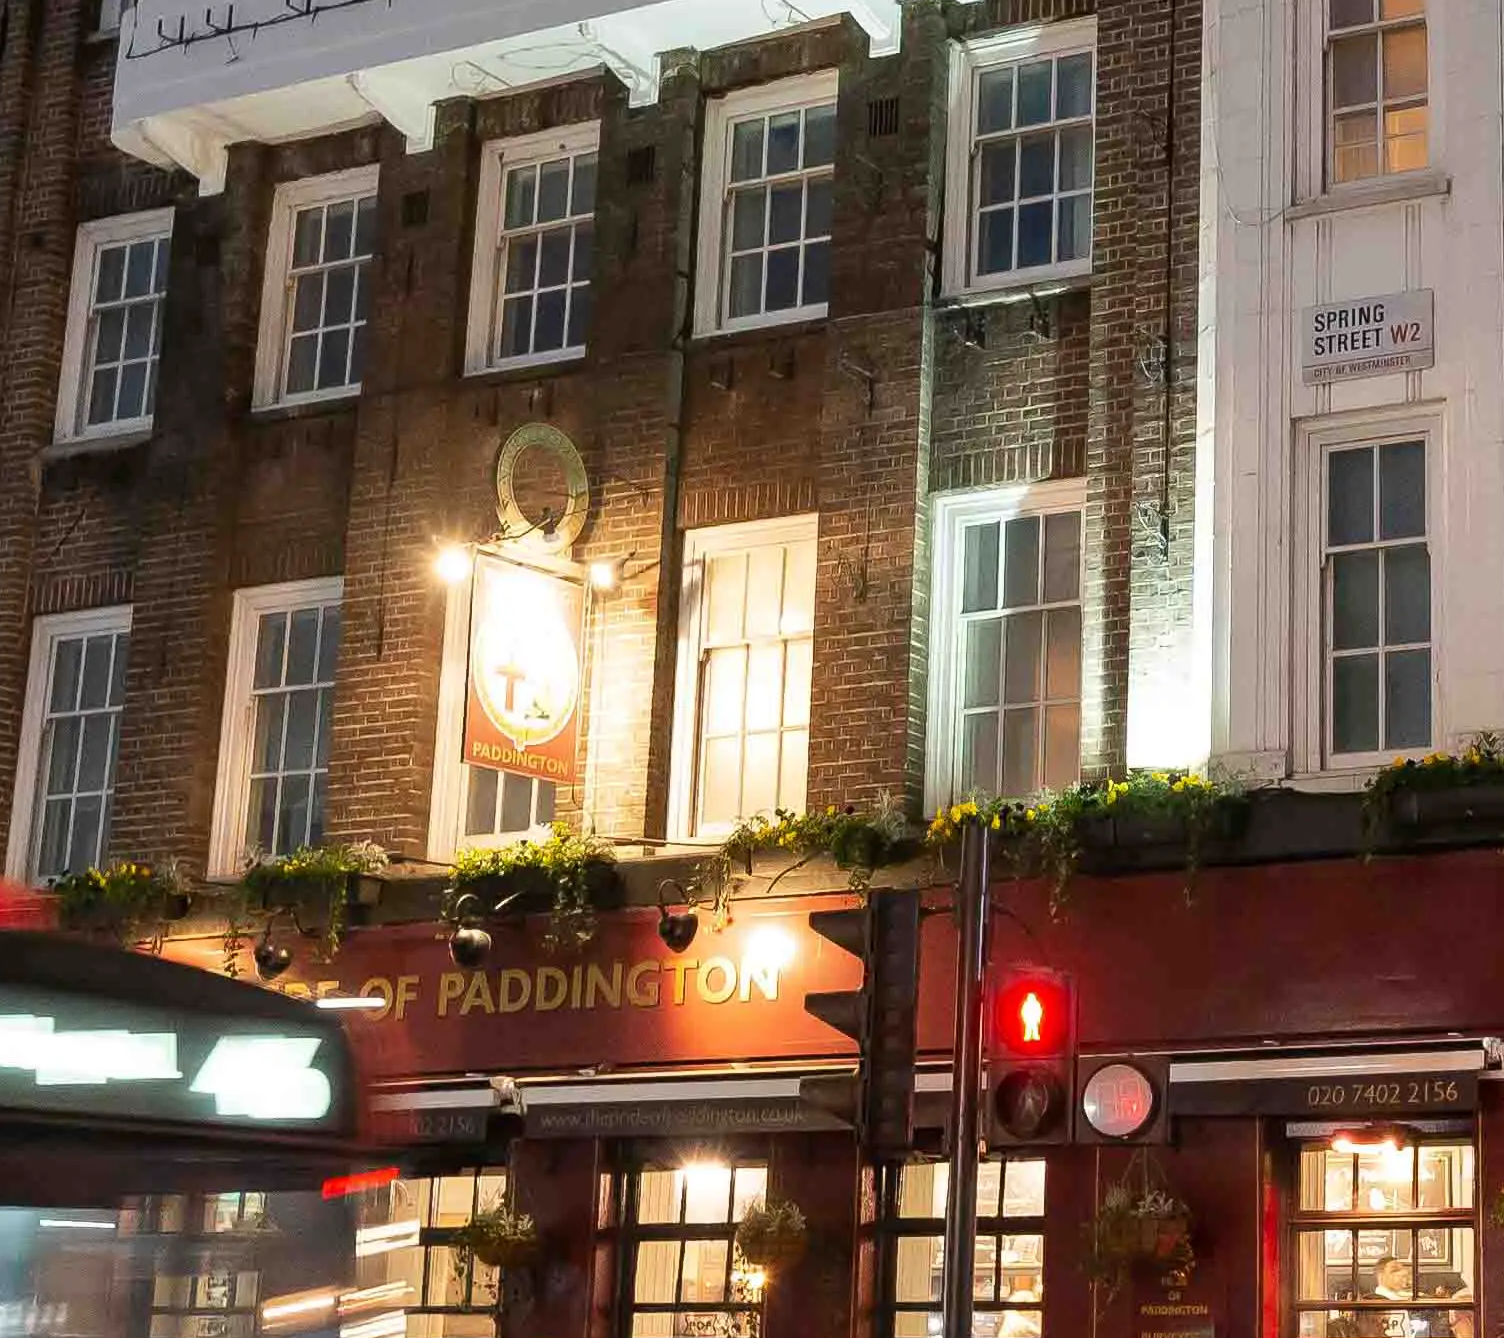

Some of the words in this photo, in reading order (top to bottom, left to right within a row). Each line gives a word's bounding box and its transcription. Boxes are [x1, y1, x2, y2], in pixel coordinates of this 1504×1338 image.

[1314, 303, 1385, 333] SPRING
[1314, 327, 1384, 356] STREET
[1390, 322, 1421, 345] W2
[1313, 365, 1333, 378] CITY
[1335, 364, 1346, 375] OF
[1348, 355, 1411, 374] WESTMINSTER
[471, 740, 569, 777] PADDINGTON
[359, 974, 421, 1022] OF
[438, 957, 783, 1019] PADDINGTON
[1308, 1084, 1345, 1106] 020
[1352, 1082, 1401, 1105] 7402
[1407, 1081, 1458, 1104] 2156
[1140, 1304, 1208, 1316] PADDINGTON
